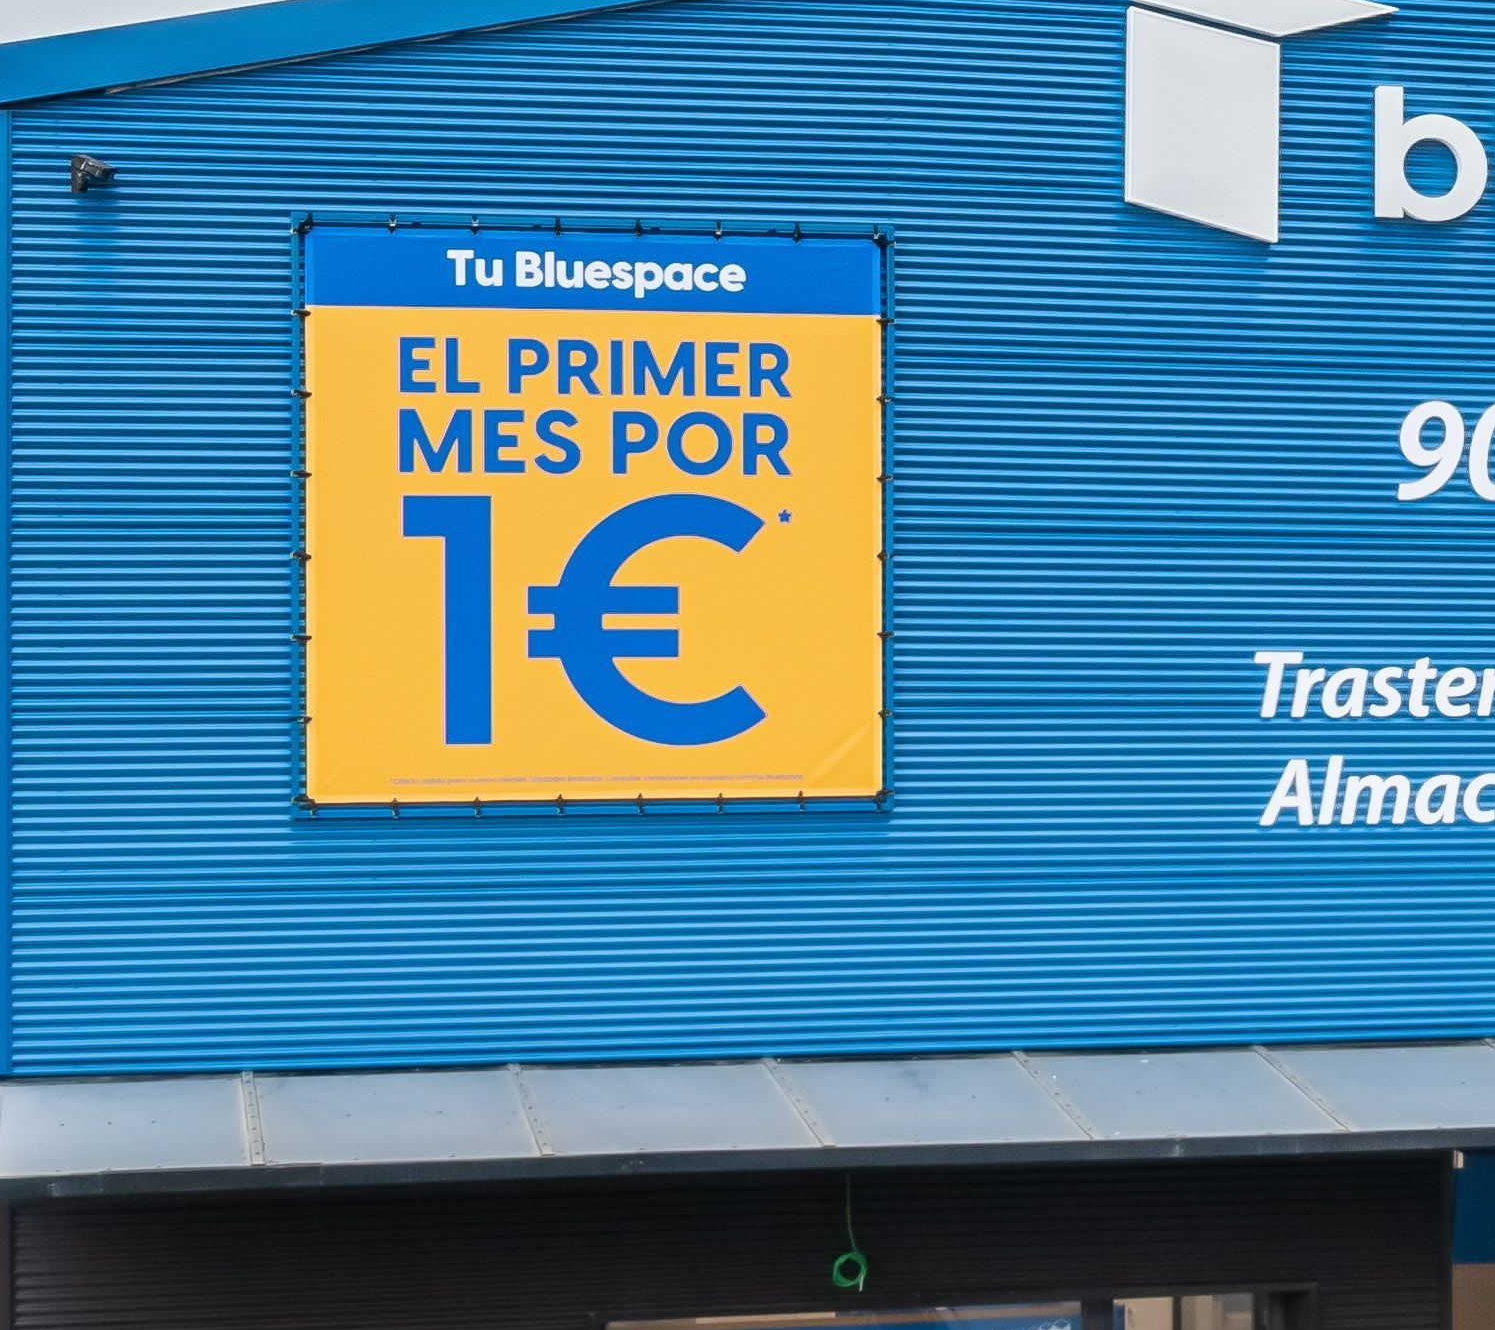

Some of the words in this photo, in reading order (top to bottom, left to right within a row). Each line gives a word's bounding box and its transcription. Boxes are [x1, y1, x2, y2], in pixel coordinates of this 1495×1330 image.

[447, 249, 503, 287] Tu
[515, 250, 747, 299] Bluespace
[399, 337, 480, 393] EL
[507, 338, 791, 398] PRIMER
[399, 409, 581, 474] MES
[612, 411, 791, 476] POR
